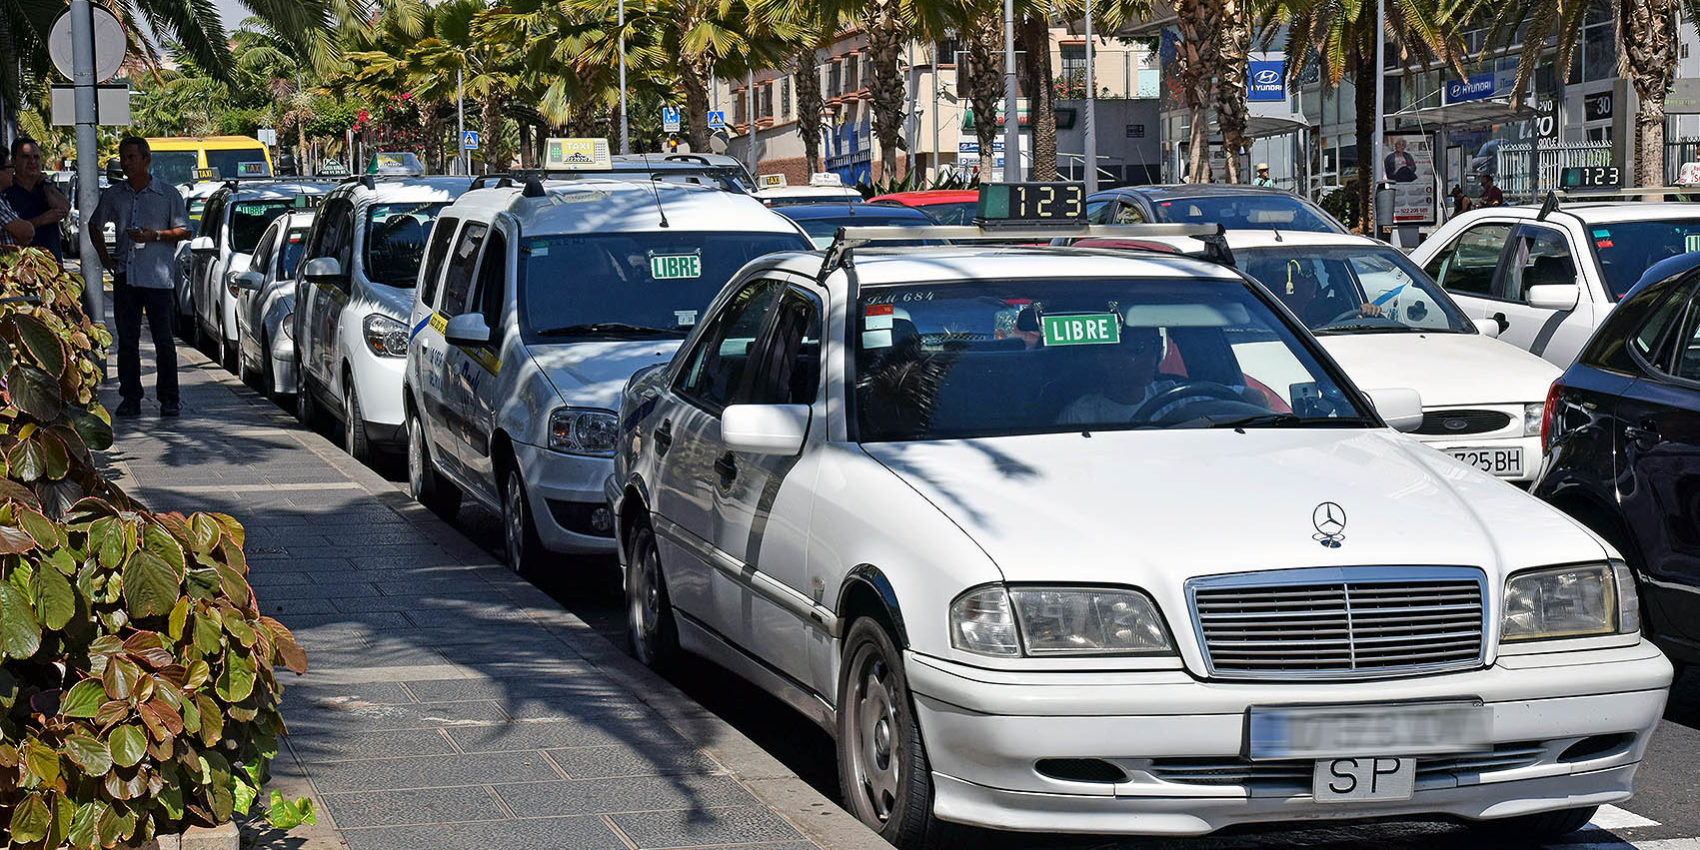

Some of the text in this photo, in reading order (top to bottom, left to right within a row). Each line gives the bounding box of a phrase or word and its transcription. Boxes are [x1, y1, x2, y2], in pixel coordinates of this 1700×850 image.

[1462, 81, 1492, 95] HYUNDAI
[1596, 96, 1611, 115] 30
[566, 142, 591, 151] TAXI
[199, 170, 213, 178] TAXI
[244, 163, 263, 173] TAXI
[767, 175, 780, 185] TAXI
[1584, 168, 1619, 185] 123
[1017, 186, 1082, 217] 123
[653, 256, 698, 278] LIBRE
[902, 291, 935, 302] 684
[1053, 319, 1110, 341] LIBRE
[1328, 757, 1401, 795] SP
